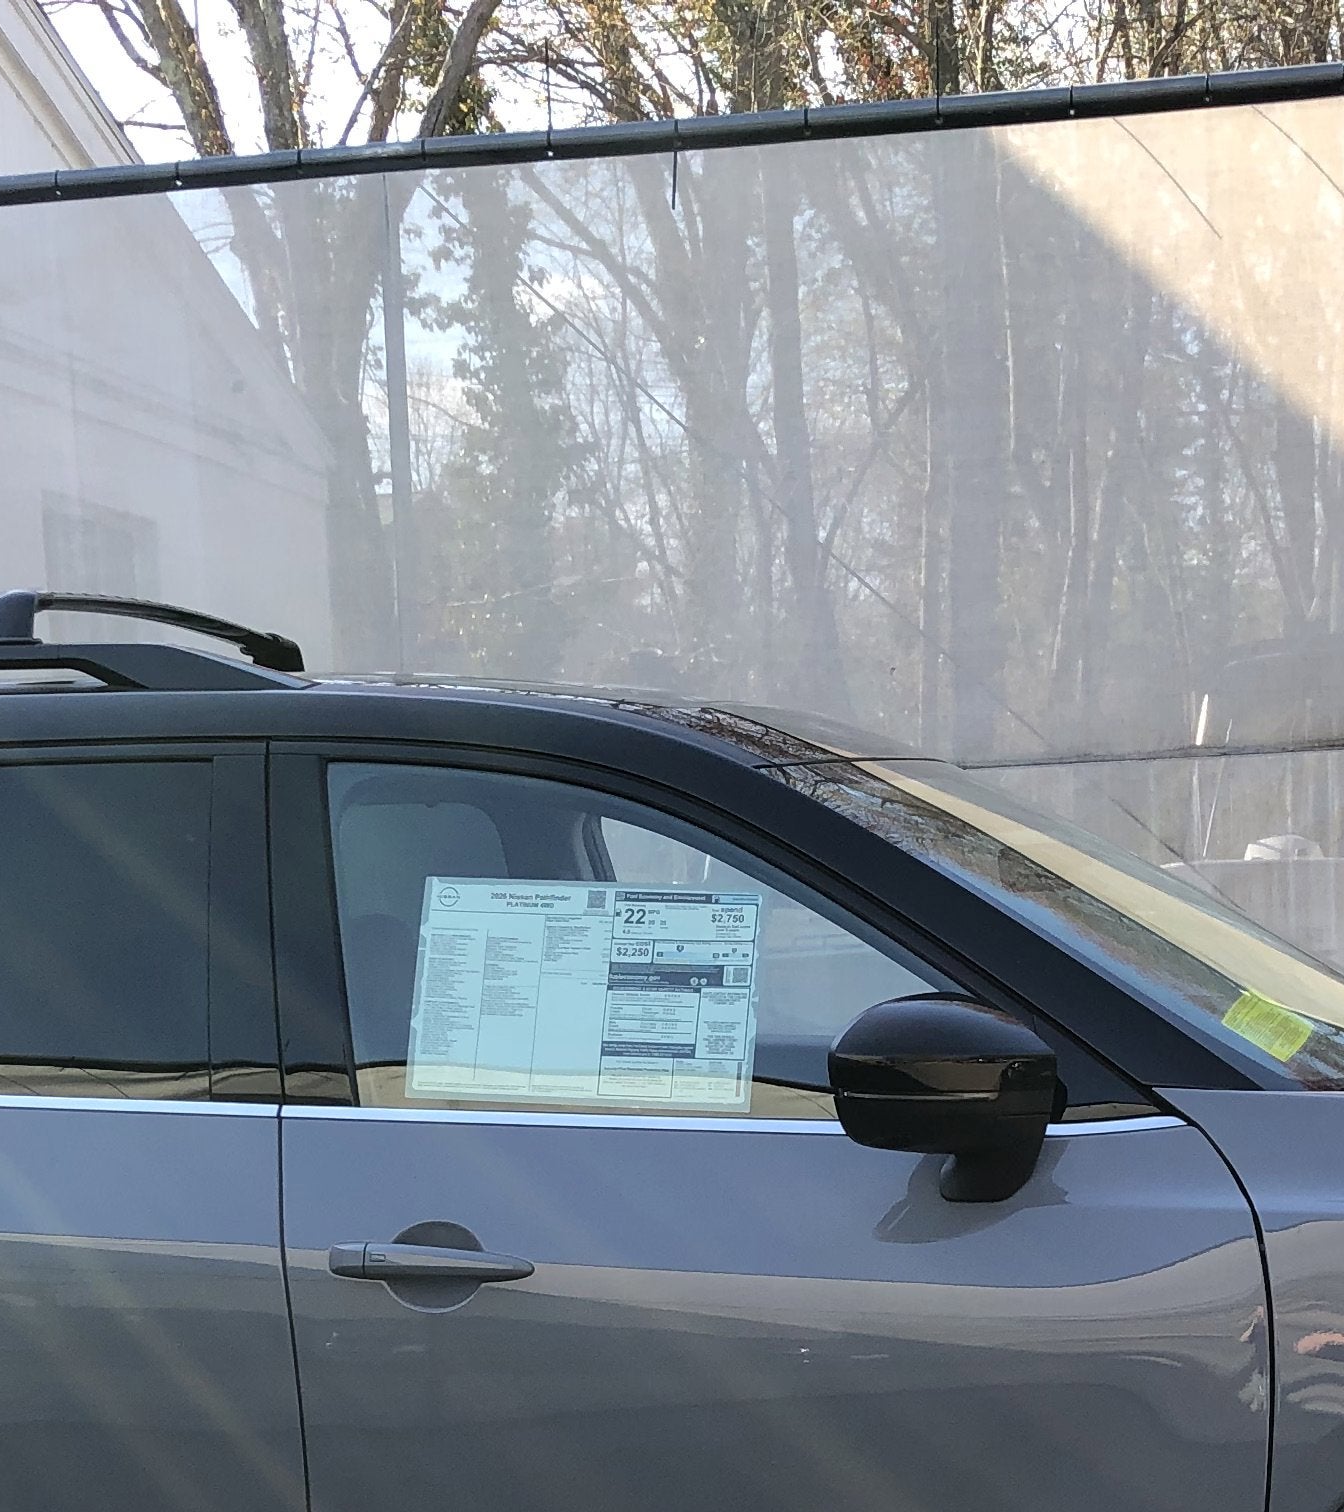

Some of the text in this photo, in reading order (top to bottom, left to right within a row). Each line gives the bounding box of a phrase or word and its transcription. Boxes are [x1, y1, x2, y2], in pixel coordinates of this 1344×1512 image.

[508, 892, 534, 901] Nissan
[534, 893, 572, 902] Pathfinder
[506, 901, 539, 909] PLATINUM
[623, 908, 647, 925] 22
[711, 913, 746, 924] $2,750
[615, 946, 650, 958] $2,250
